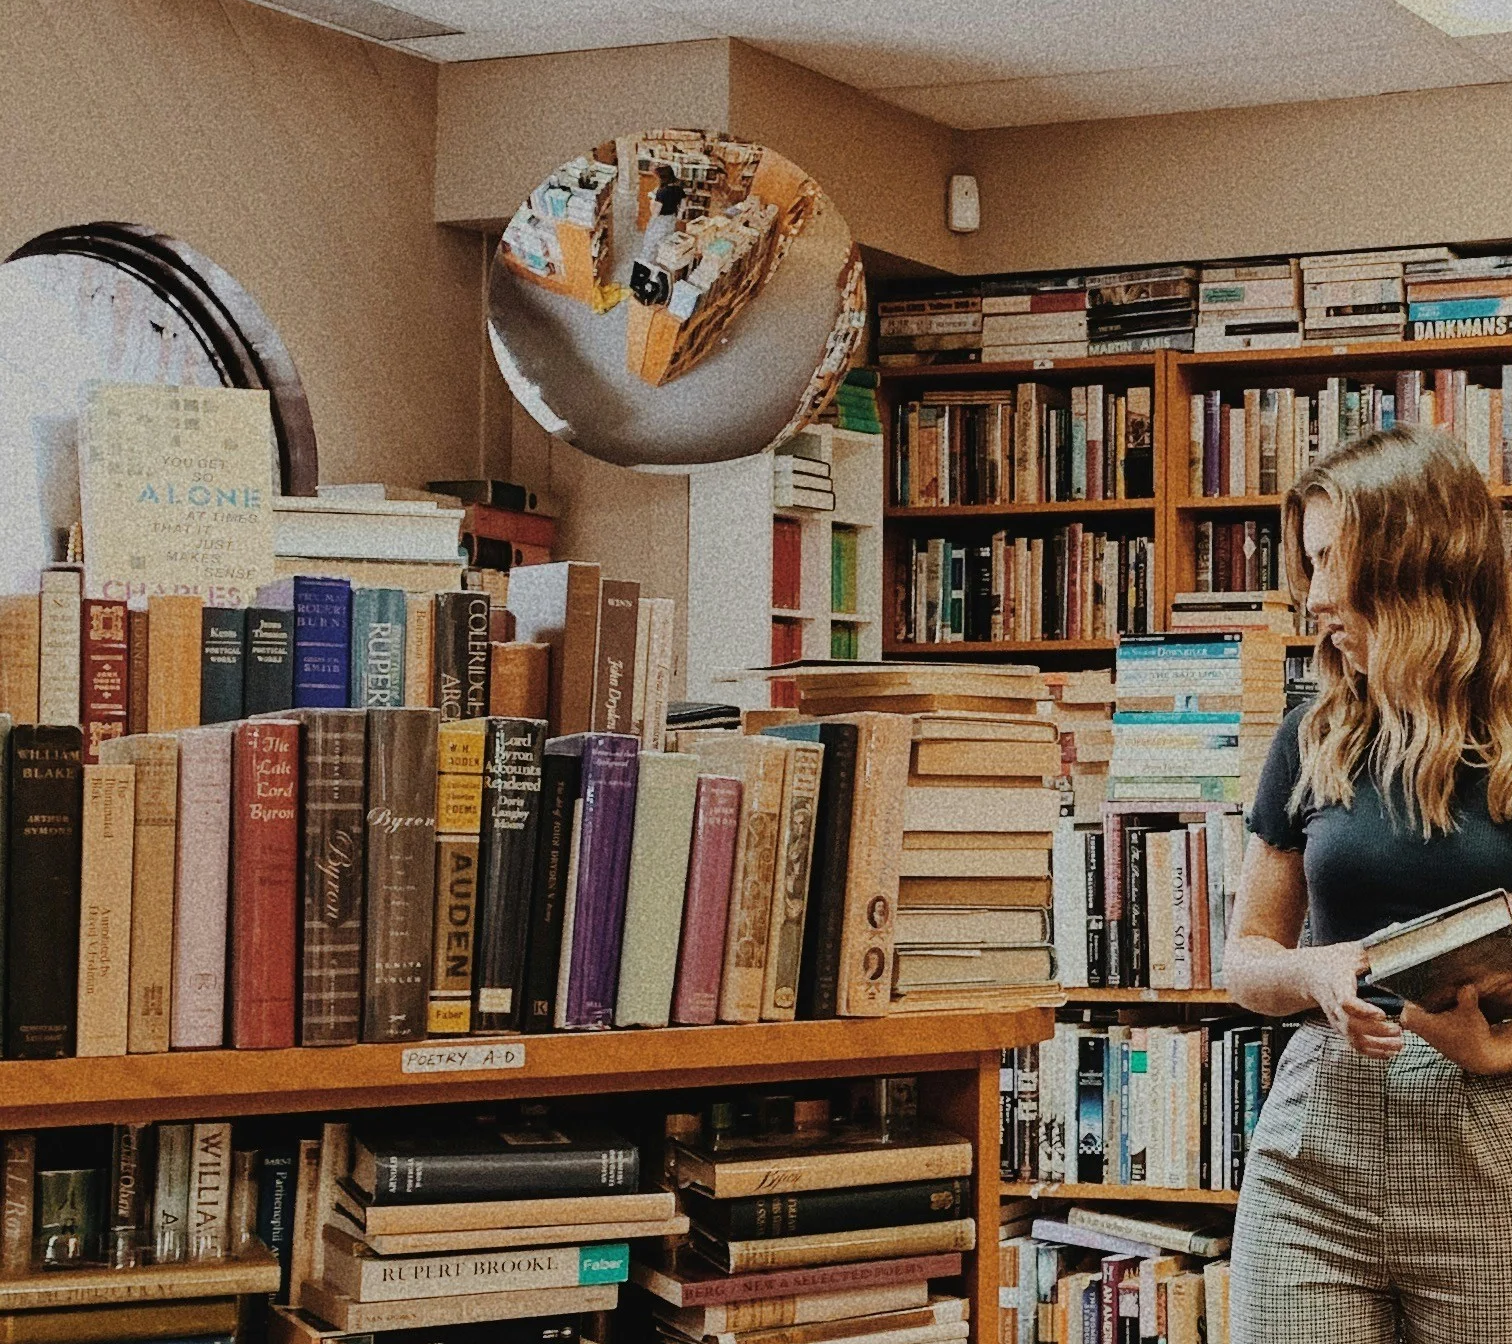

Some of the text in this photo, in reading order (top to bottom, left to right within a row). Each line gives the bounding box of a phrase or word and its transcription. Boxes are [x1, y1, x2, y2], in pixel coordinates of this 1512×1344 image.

[1414, 316, 1508, 340] DARKMANS
[1089, 338, 1171, 354] MARTIN AMIS
[192, 473, 213, 483] SO
[137, 483, 261, 508] ALONE
[187, 511, 205, 521] AT
[604, 657, 624, 729] John Dryden
[22, 767, 74, 780] BLAKE
[257, 781, 294, 799] Lord
[249, 803, 295, 822] Byron
[366, 807, 436, 834] Byron
[315, 829, 353, 920] Byron
[446, 851, 474, 981] AUDEN
[435, 1009, 464, 1022] Faber
[406, 1050, 515, 1067] POETRY A-D
[382, 1256, 560, 1282] RUPERT BROOKE
[583, 1258, 622, 1271] Faber
[1103, 1285, 1113, 1304] AN
